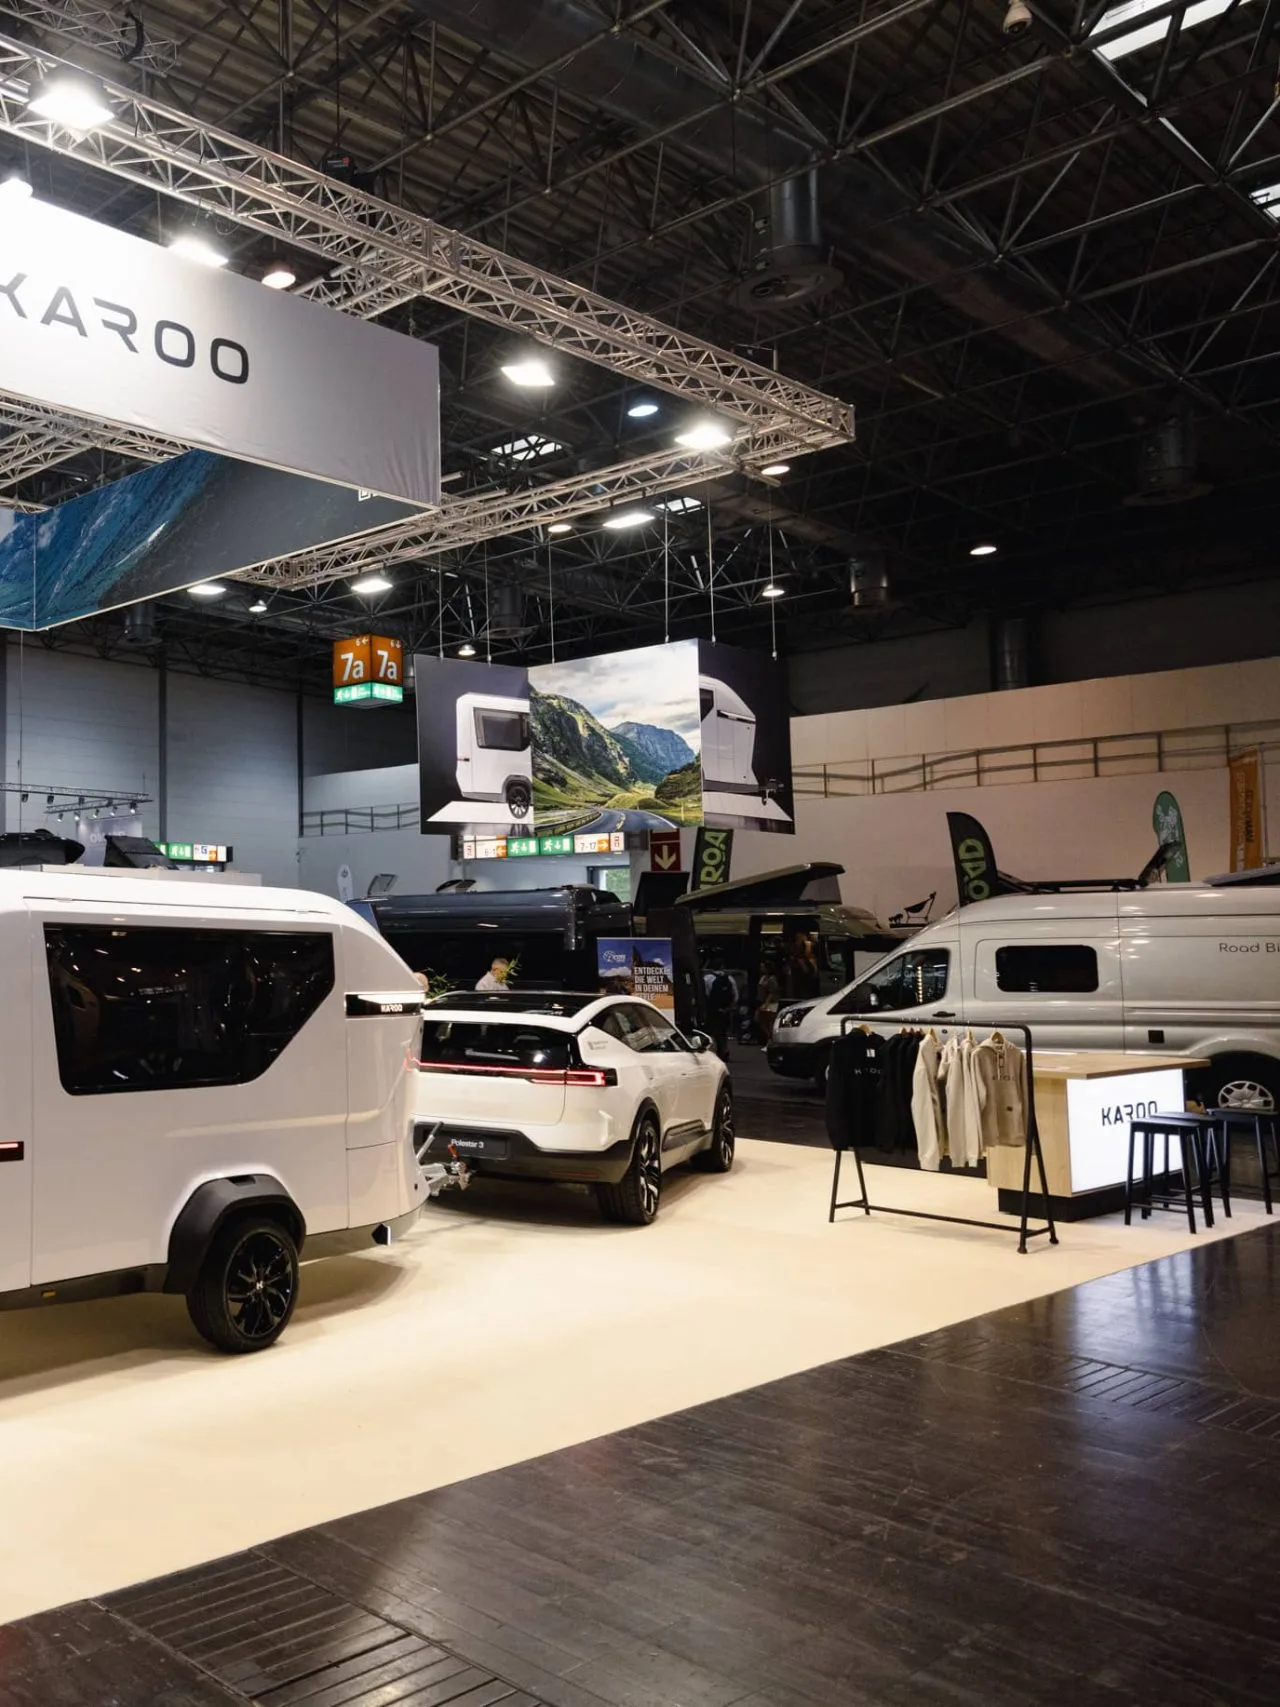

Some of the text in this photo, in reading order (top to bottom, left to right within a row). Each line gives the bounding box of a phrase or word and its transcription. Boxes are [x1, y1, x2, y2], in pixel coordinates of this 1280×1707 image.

[341, 652, 364, 681] 7a
[376, 649, 398, 680] 7a
[701, 831, 728, 888] ROA
[958, 838, 990, 900] OAD
[1219, 942, 1260, 953] Road
[634, 975, 665, 984] DIE WELT
[643, 984, 669, 993] DEINEM
[380, 1004, 403, 1013] KAROO
[1101, 1100, 1158, 1127] KAROO
[450, 1138, 485, 1149] Polestar 3
